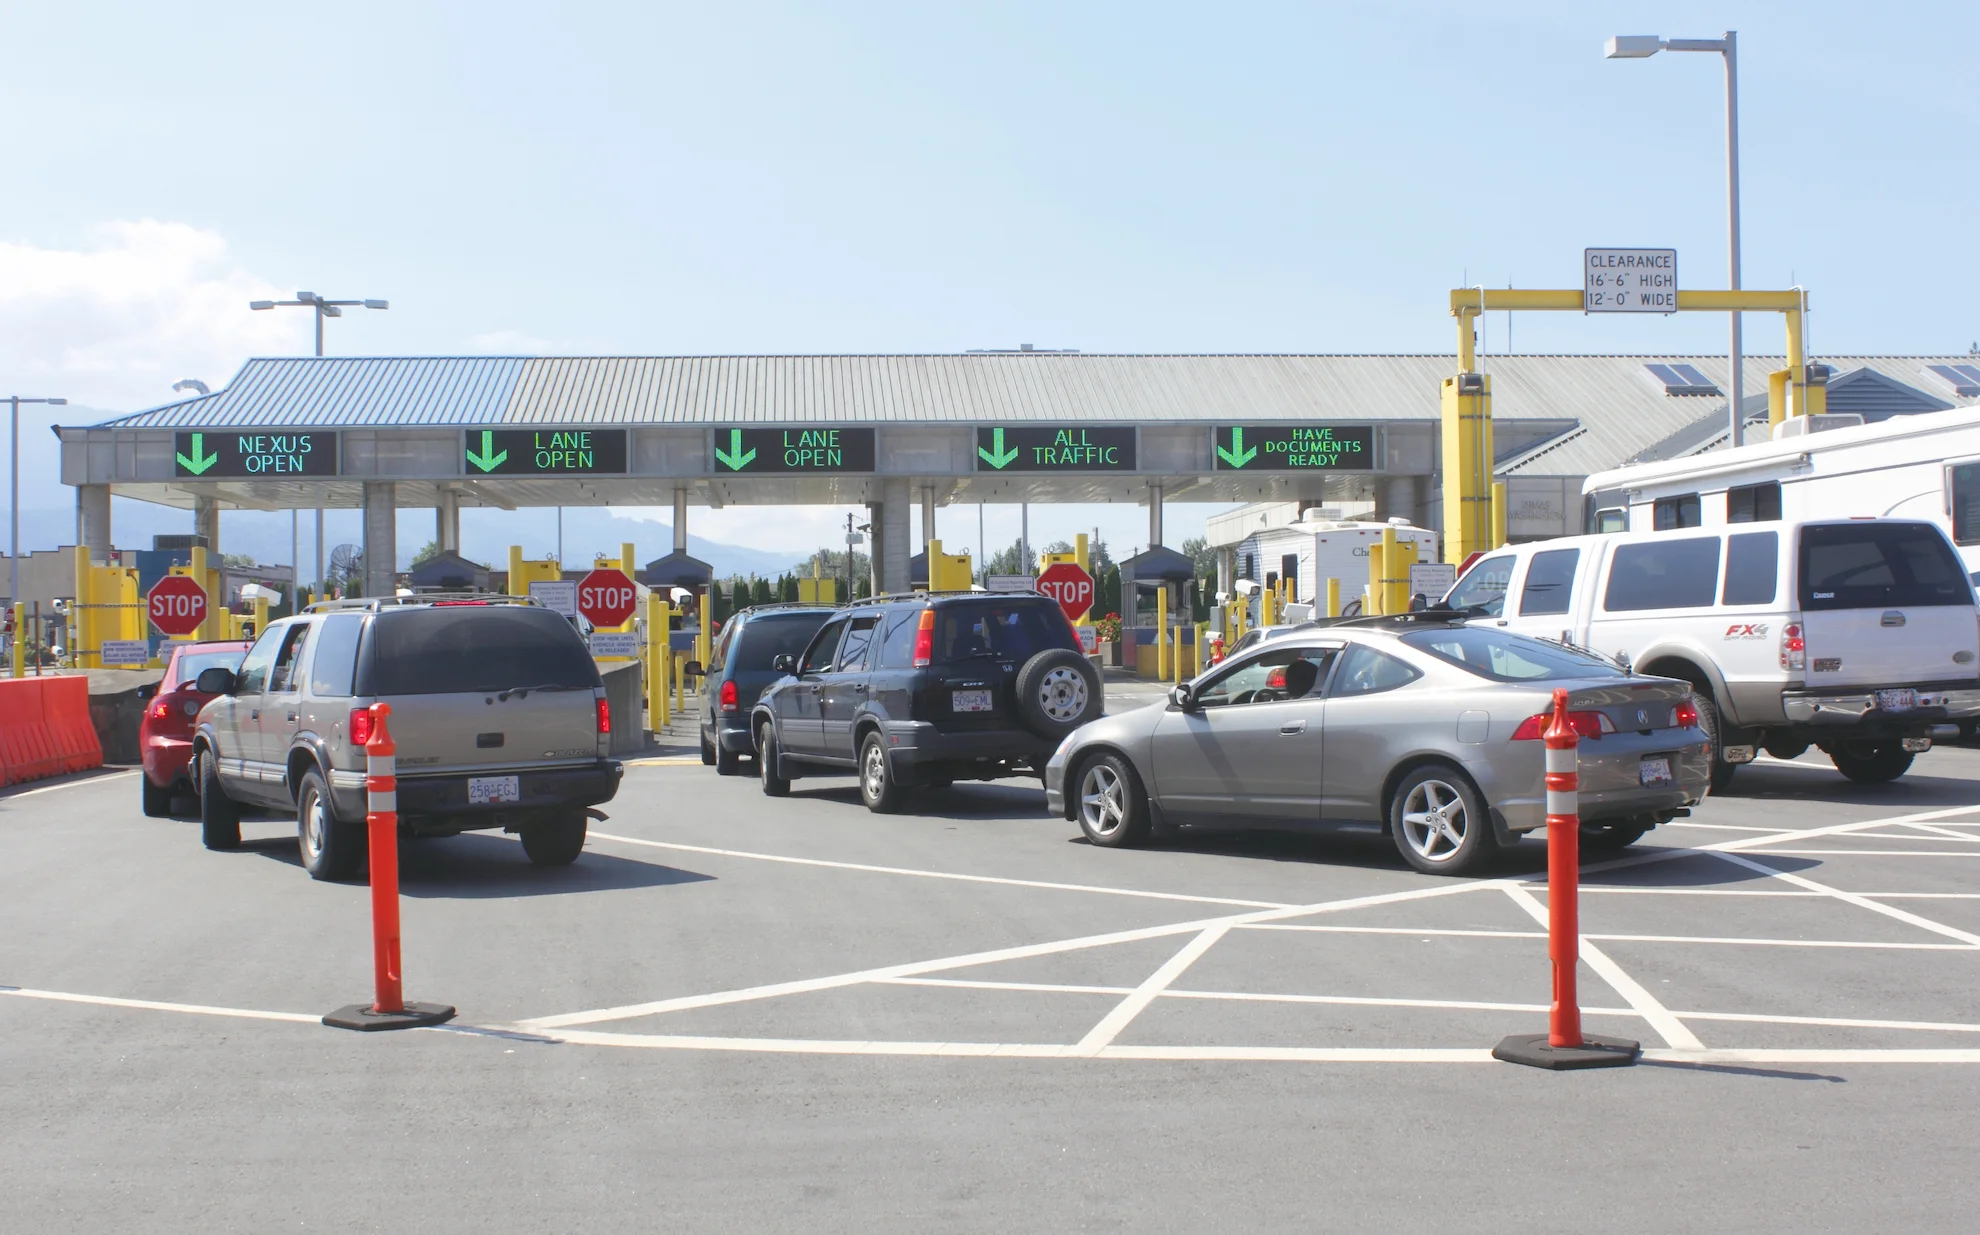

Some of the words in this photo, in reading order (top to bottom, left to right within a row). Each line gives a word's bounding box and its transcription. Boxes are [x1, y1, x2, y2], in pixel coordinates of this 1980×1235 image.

[1590, 255, 1671, 268] CLEARANCE
[1640, 274, 1673, 287] HIGH
[1640, 293, 1674, 306] WIDE
[535, 432, 592, 449] LANE
[784, 430, 840, 448] LANE
[1054, 429, 1092, 446] ALL
[1293, 428, 1333, 440] HAVE
[239, 436, 312, 453] NEXUS
[1265, 441, 1361, 453] DOCUMENTS
[245, 455, 303, 472] OPEN
[535, 450, 593, 468] OPEN
[784, 449, 842, 466] OPEN
[1032, 447, 1118, 464] TRAFFIC
[1288, 454, 1338, 466] READY
[581, 587, 633, 609] STOP
[1040, 581, 1090, 603] STOP
[152, 595, 204, 617] STOP
[1725, 623, 1769, 636] FX4
[1727, 748, 1748, 759] Ford
